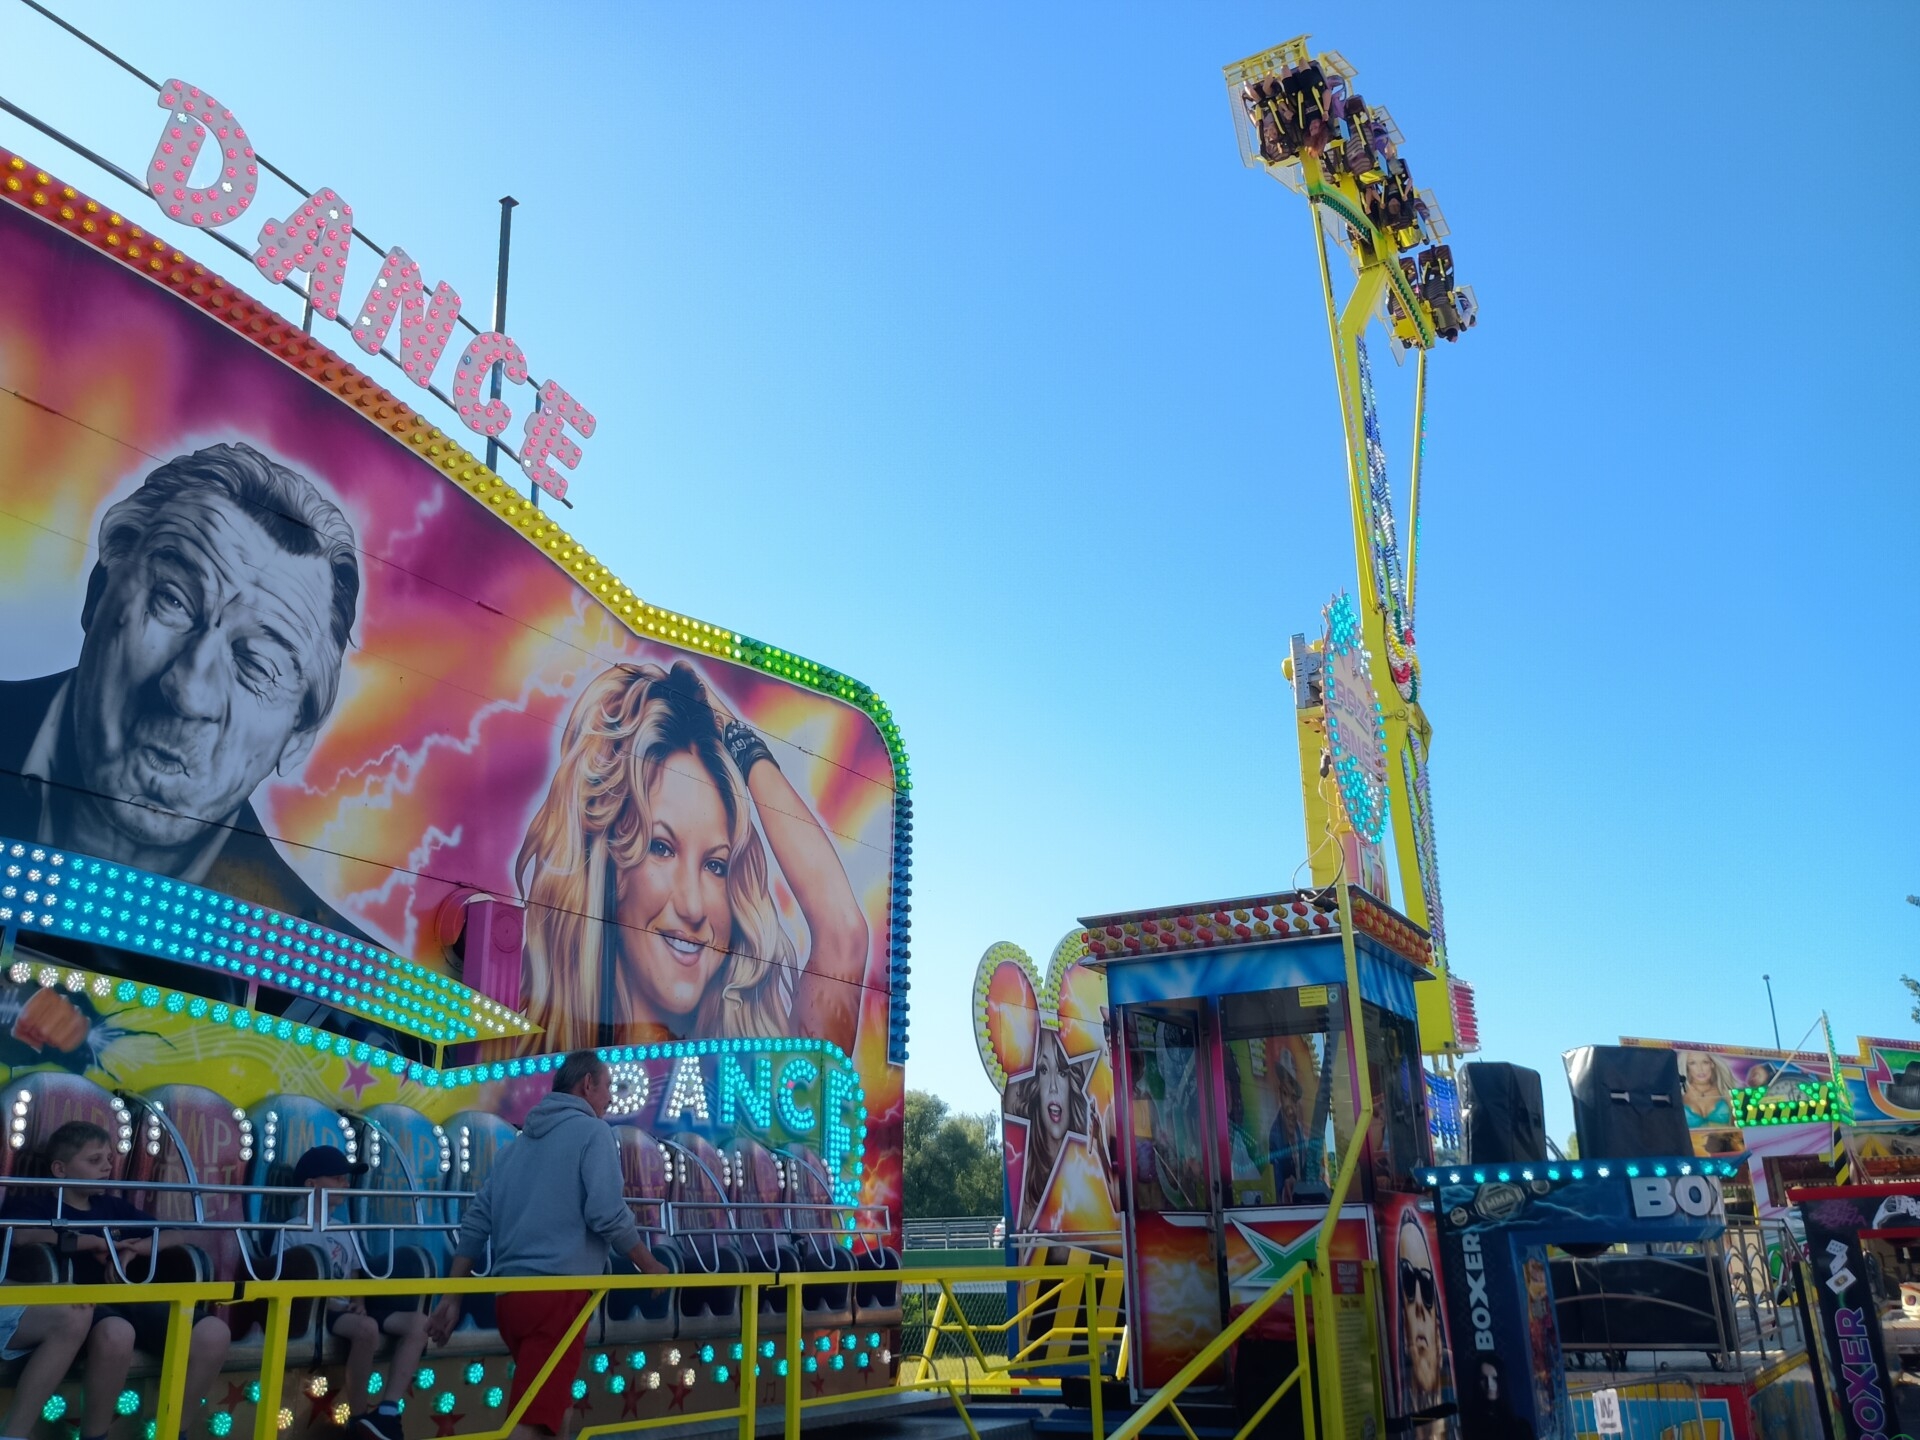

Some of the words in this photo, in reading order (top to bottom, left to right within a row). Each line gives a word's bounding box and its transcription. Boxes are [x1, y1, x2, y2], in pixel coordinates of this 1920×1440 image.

[147, 78, 597, 500] DANCE
[605, 1052, 860, 1208] DANCE
[1462, 1232, 1495, 1350] BOXER
